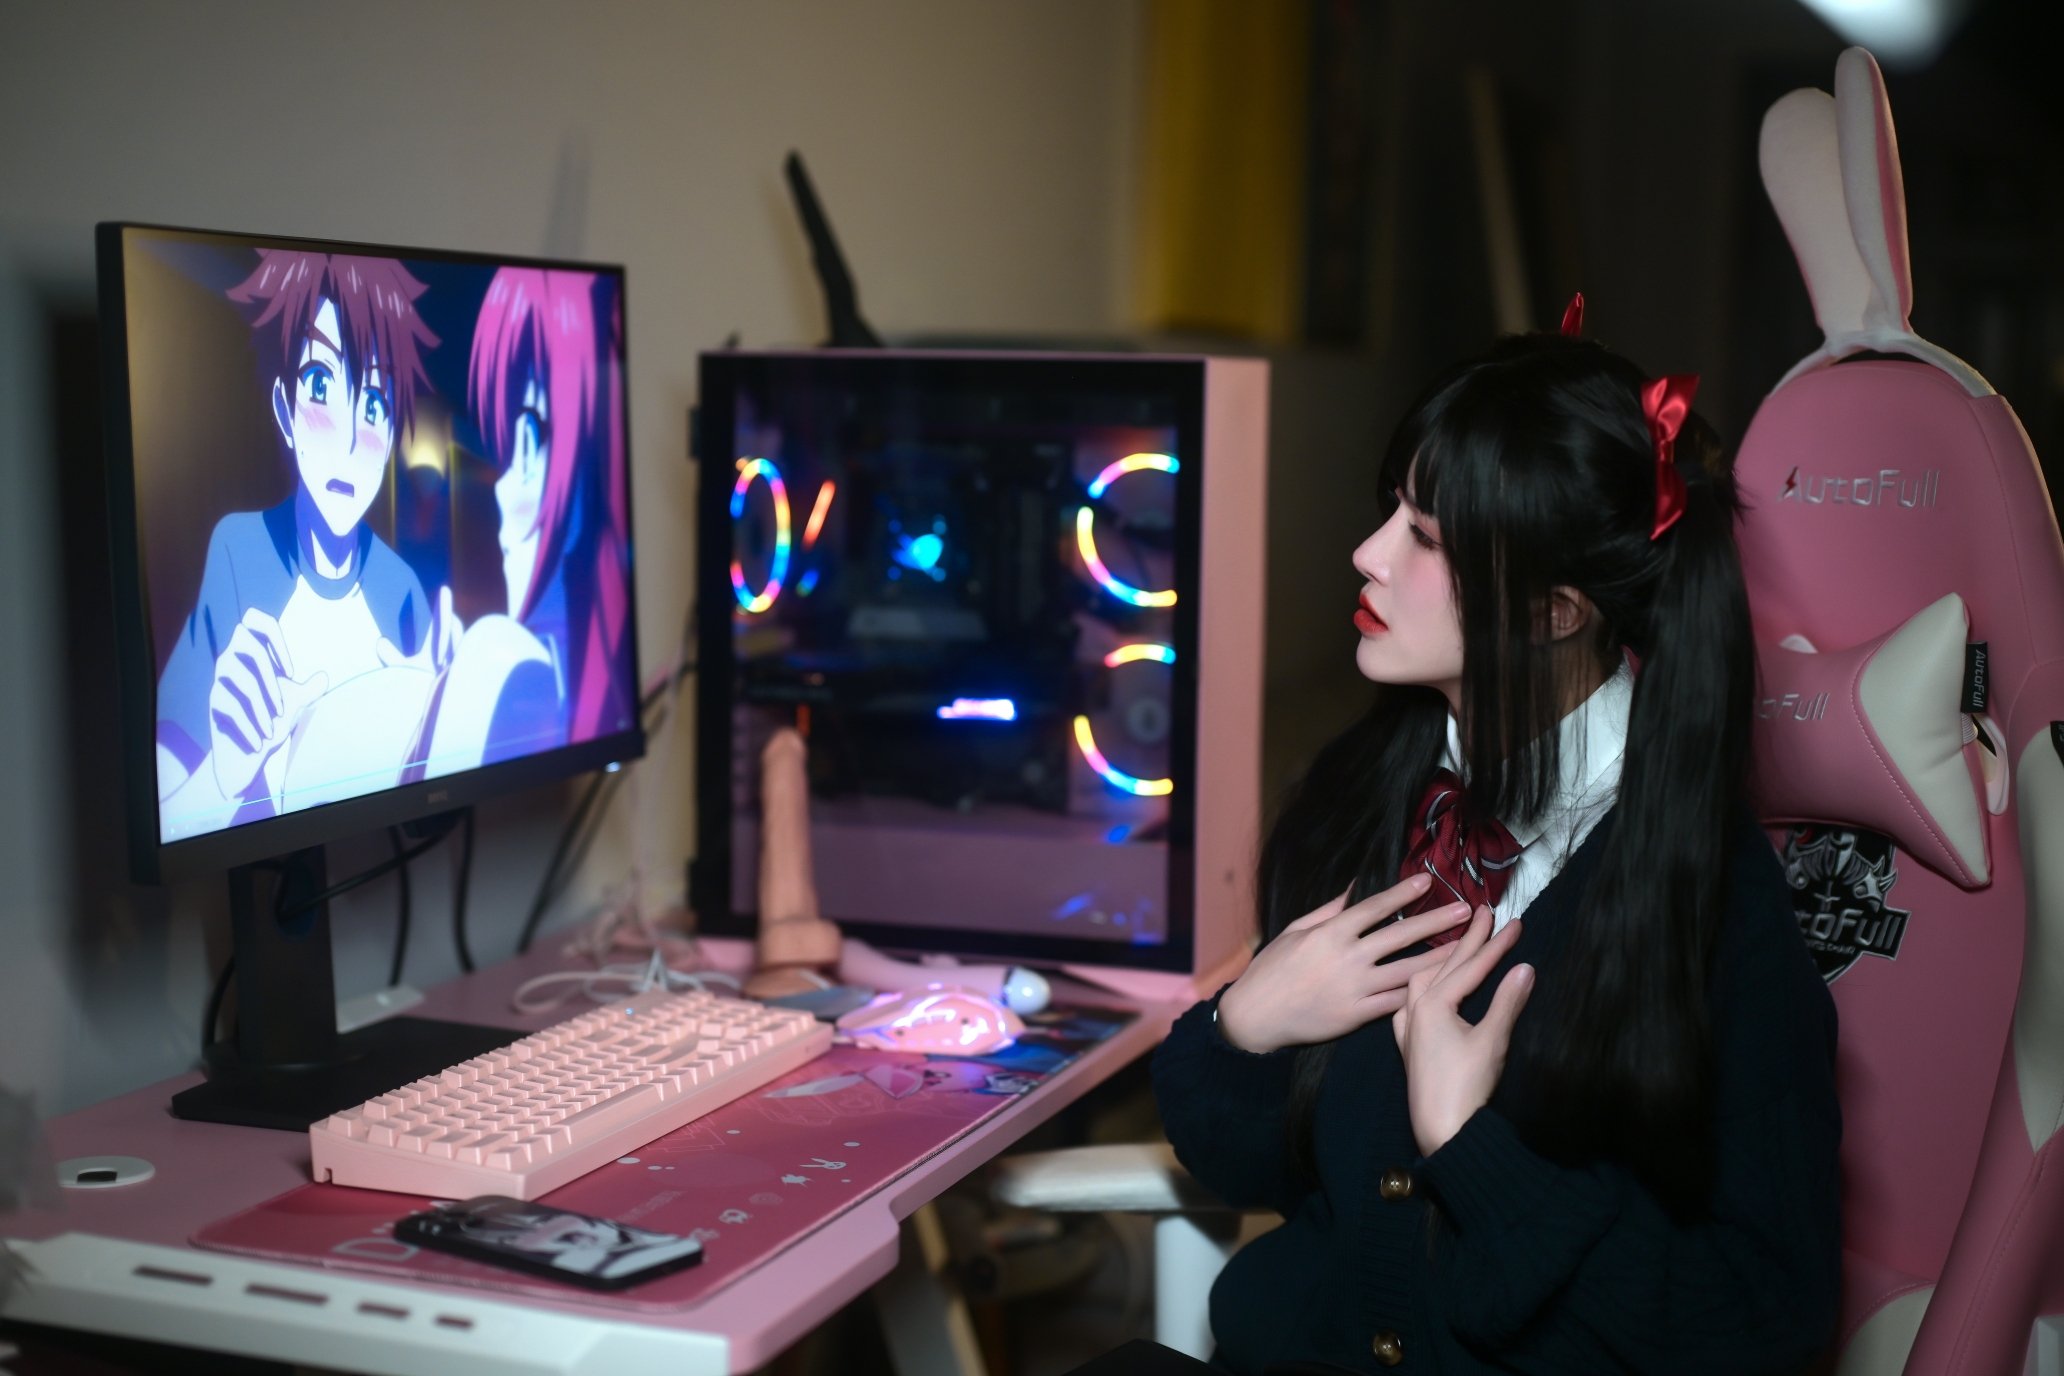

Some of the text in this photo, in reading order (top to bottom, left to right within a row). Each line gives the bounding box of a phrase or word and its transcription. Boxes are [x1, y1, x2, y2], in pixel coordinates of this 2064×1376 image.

[1776, 466, 1940, 508] AutoFull
[1973, 649, 1987, 708] AutoFull
[1757, 691, 1831, 721] oFull
[1793, 907, 1903, 949] toFull
